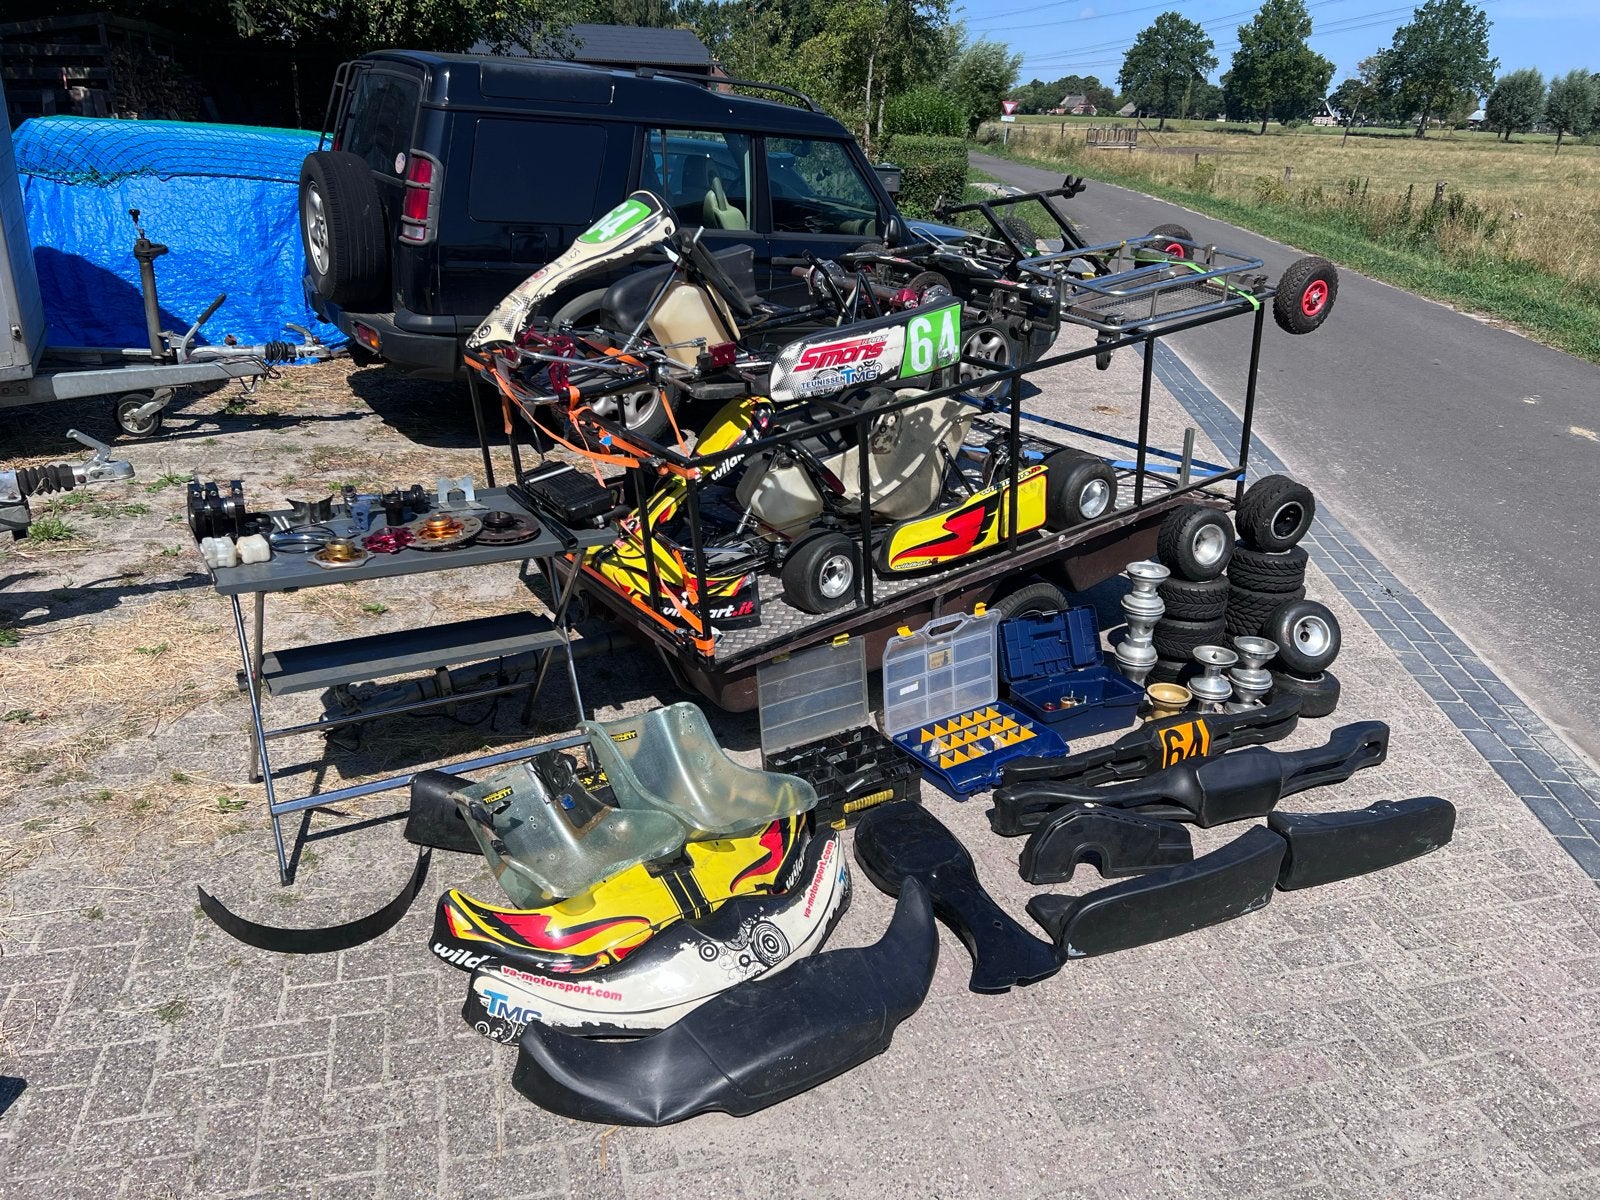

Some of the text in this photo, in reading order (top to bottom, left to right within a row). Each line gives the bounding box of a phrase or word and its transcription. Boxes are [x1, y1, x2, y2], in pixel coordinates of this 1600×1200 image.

[910, 311, 959, 373] 64
[801, 375, 845, 388] TEUNISSEN
[841, 368, 877, 384] TMG
[1164, 721, 1204, 767] 64
[803, 841, 835, 918] va-motorsport.com
[501, 965, 623, 1001] va-motorsport.com
